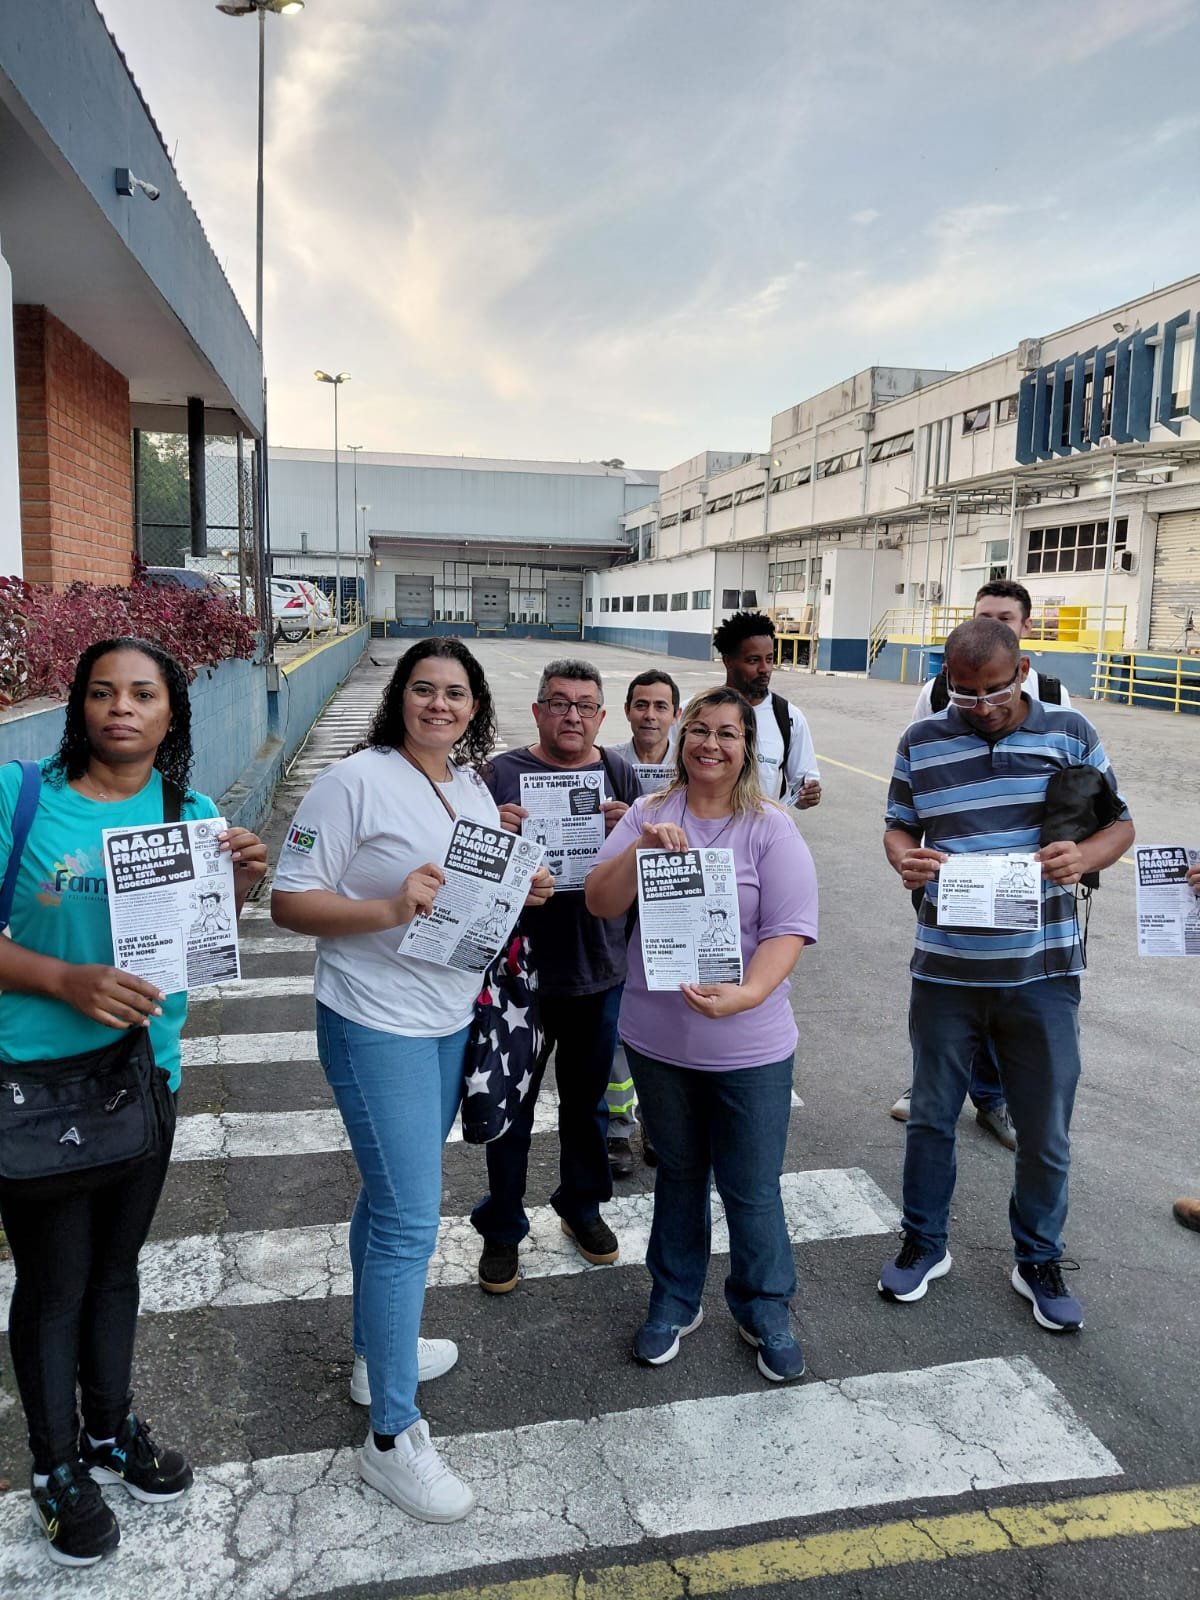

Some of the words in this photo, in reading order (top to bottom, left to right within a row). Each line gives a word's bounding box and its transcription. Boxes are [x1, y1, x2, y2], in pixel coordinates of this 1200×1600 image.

[111, 834, 165, 853] NÃO
[168, 828, 183, 844] É
[457, 824, 497, 844] NÃO
[498, 836, 510, 849] É
[112, 844, 189, 865] FRAQUEZA,
[454, 835, 508, 862] FRAQUEZA,
[1139, 850, 1173, 860] NÃO
[1174, 849, 1184, 858] É
[131, 859, 175, 872] TRABALHO
[447, 860, 483, 874] ADOECENDO
[642, 855, 682, 868] NÃO
[685, 853, 696, 864] É
[1140, 859, 1188, 868] FRAQUEZA,
[117, 874, 133, 883] QUE
[135, 869, 156, 879] ESTÁ
[643, 865, 701, 879] FRAQUEZA,
[118, 876, 166, 890] ADOECENDO
[168, 870, 191, 880] VOCÊ!
[646, 890, 683, 899] ADOECENDO
[138, 939, 173, 948] PASSANDO
